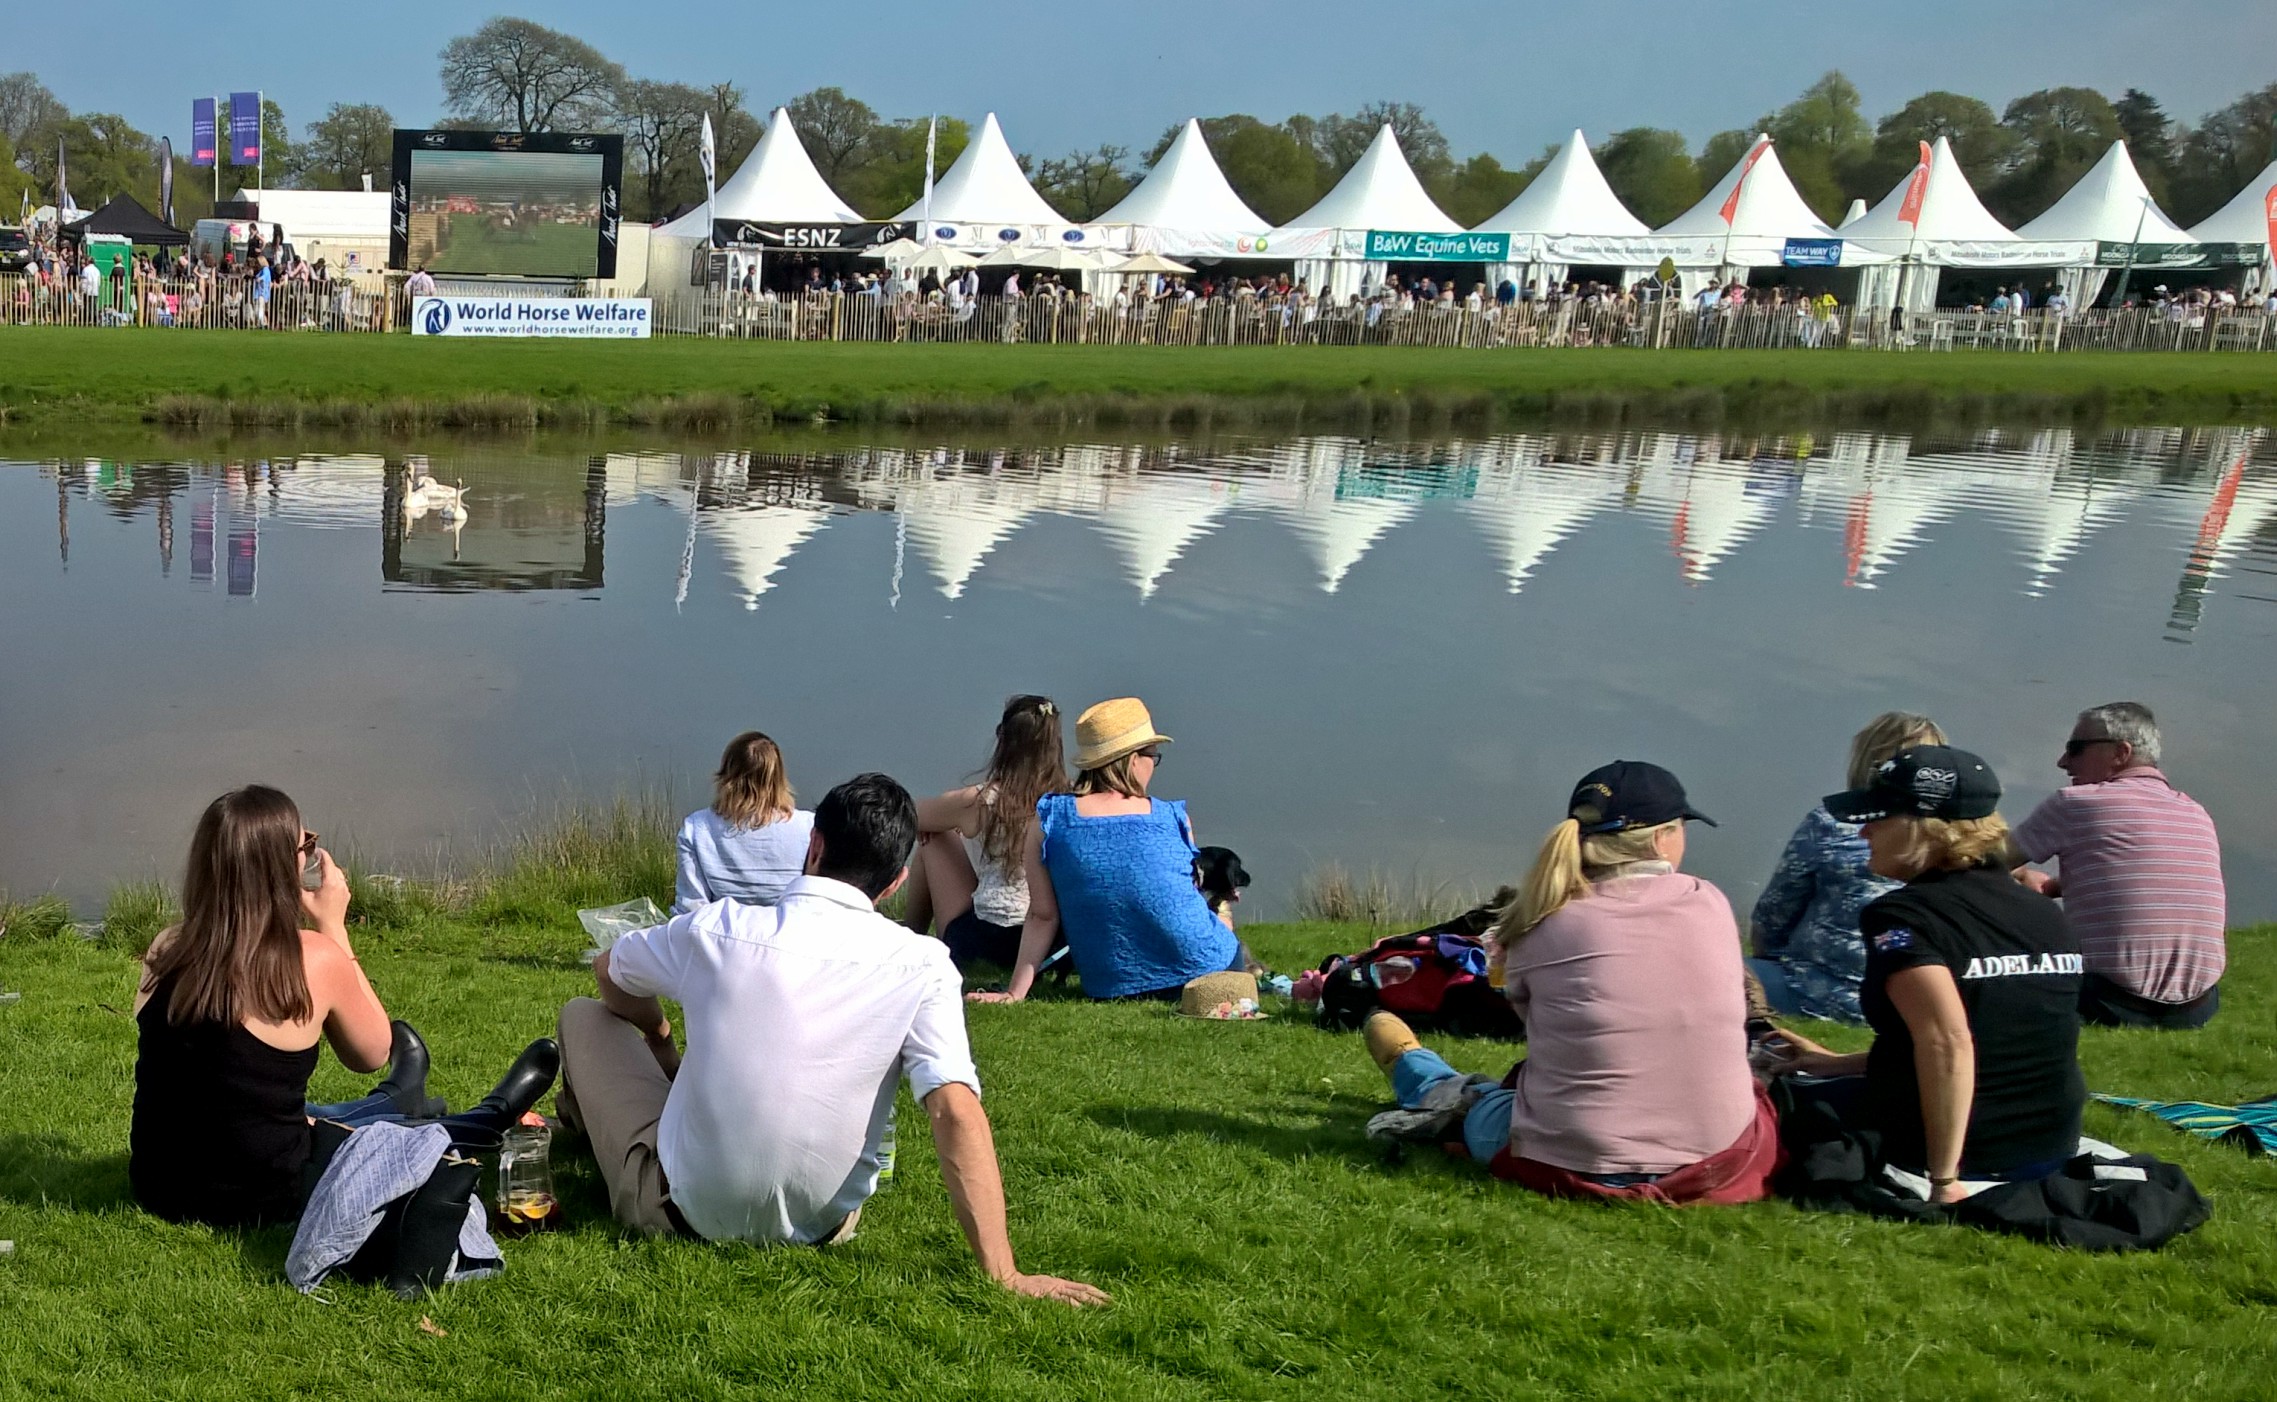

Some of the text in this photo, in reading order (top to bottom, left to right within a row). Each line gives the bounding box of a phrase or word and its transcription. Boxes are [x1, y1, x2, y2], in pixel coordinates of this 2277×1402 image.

[784, 229, 842, 247] ESNZ
[1373, 235, 1500, 258] B&W Equine Vets
[1786, 246, 1828, 256] TEAM WAY
[457, 303, 646, 322] World Horse Welfare
[462, 324, 639, 337] www.worldhorsewelfare.org
